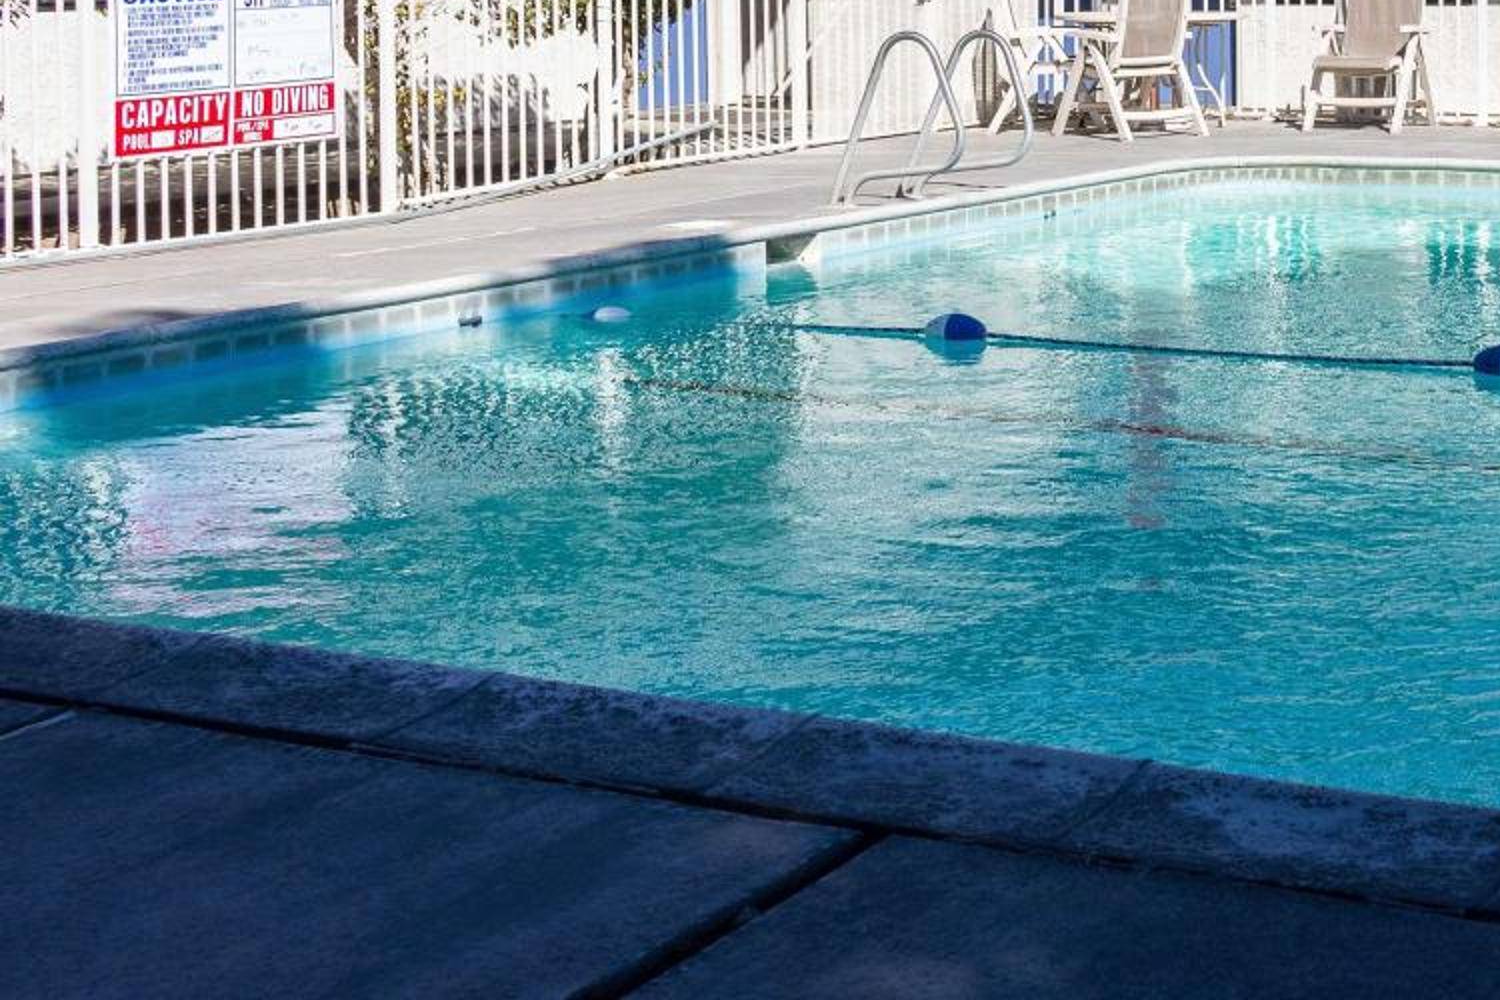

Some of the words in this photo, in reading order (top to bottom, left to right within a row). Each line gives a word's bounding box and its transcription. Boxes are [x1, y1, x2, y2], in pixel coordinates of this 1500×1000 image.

[121, 94, 227, 129] CAPACITY
[241, 90, 265, 117] NO
[272, 83, 329, 114] DIVING
[122, 132, 152, 151] POOL
[177, 127, 200, 145] SPA
